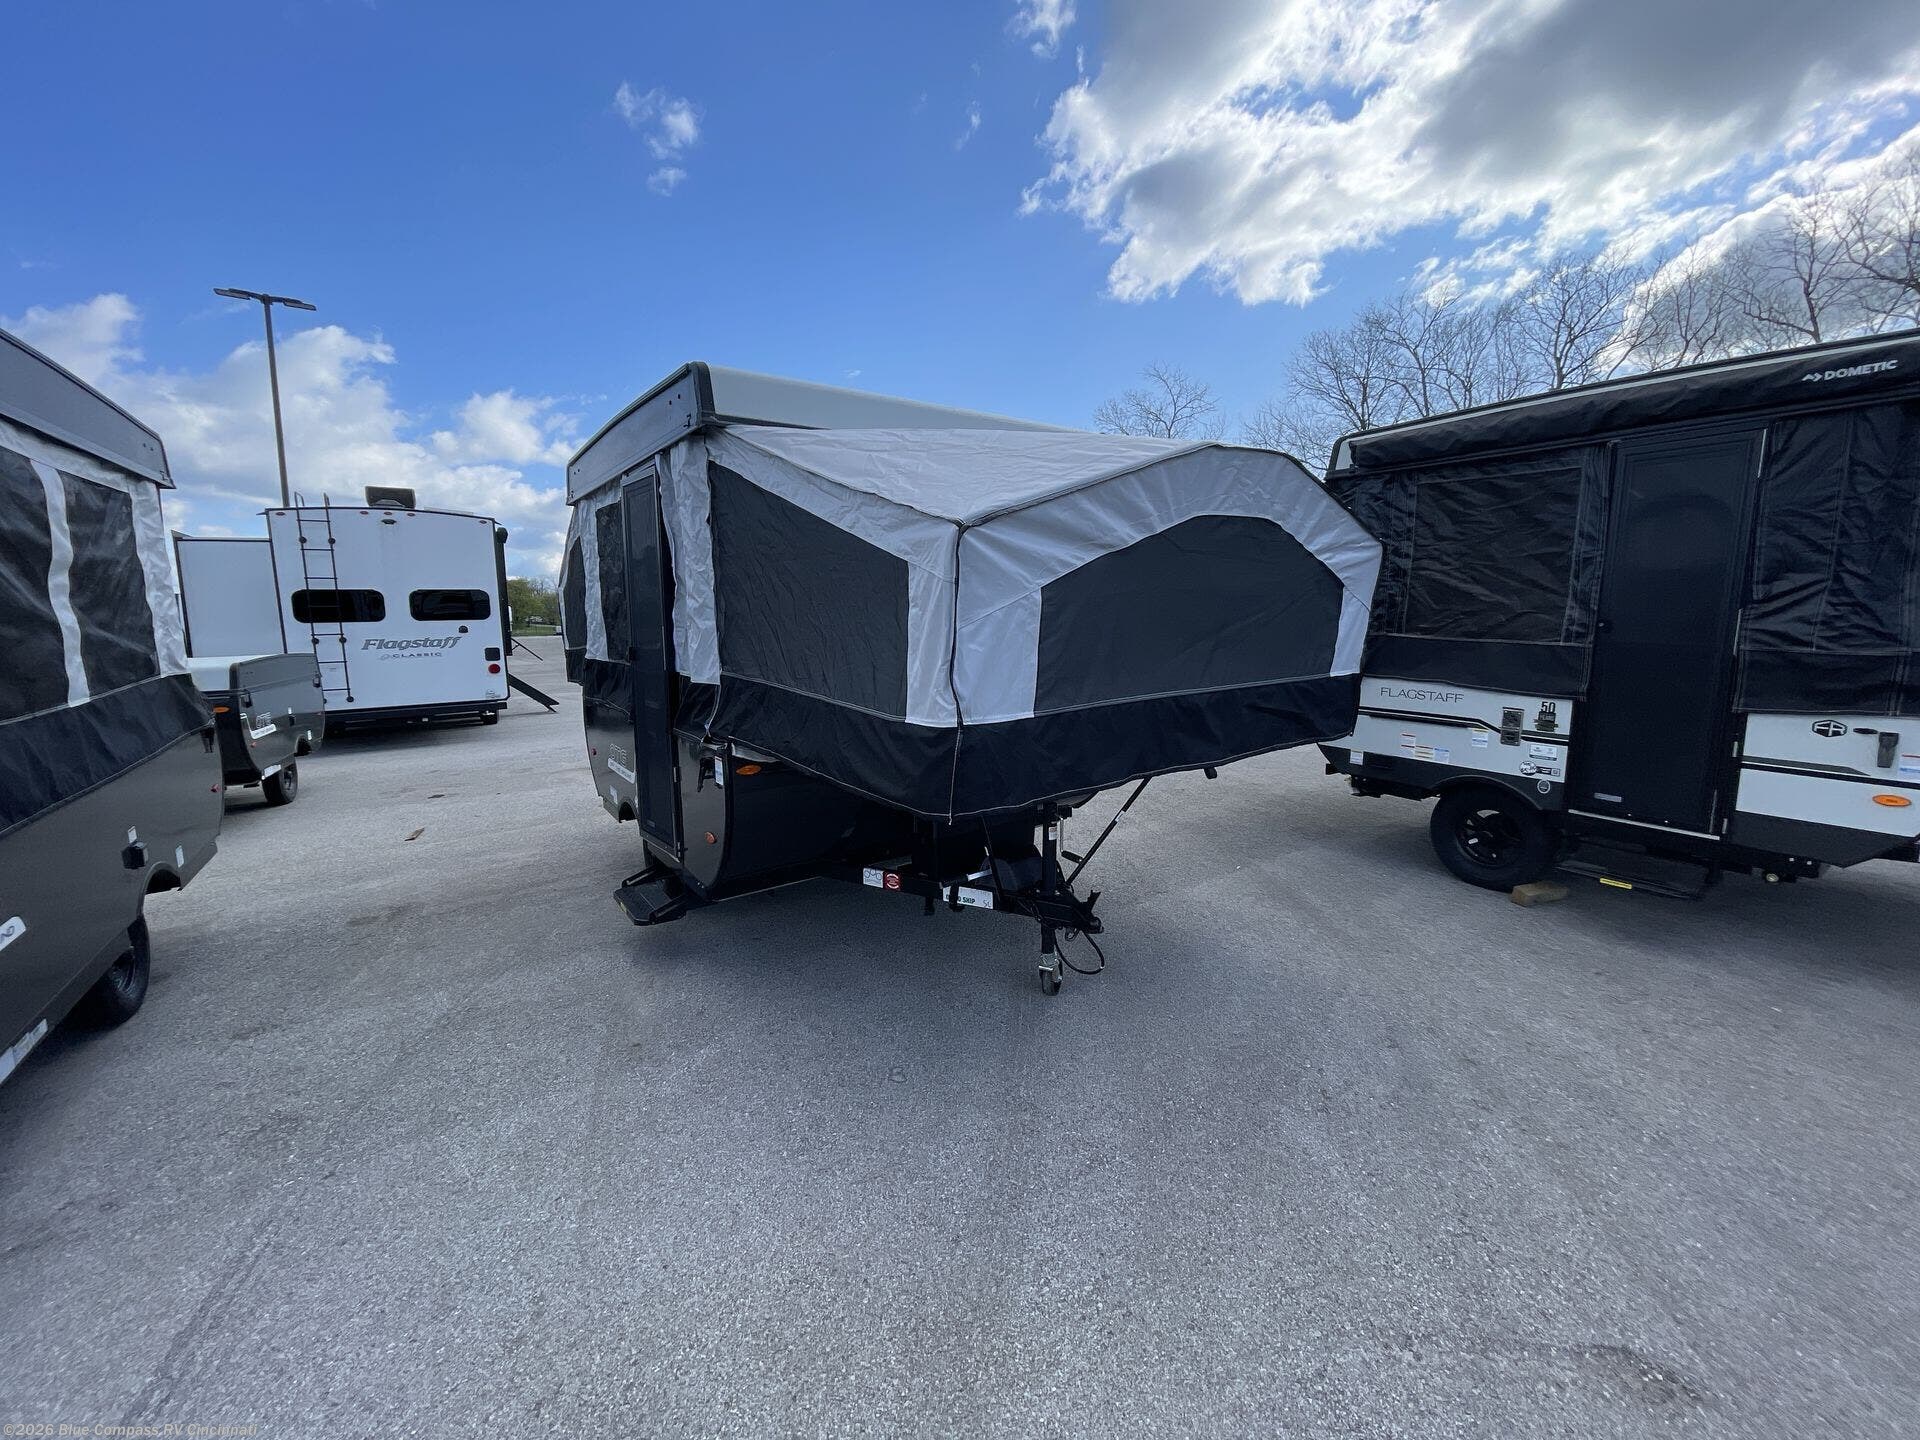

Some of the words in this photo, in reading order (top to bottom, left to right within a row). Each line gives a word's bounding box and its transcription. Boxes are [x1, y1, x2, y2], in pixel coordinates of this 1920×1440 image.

[1823, 359, 1898, 381] DOMETIC
[361, 636, 462, 651] Flagstaff
[1380, 687, 1465, 703] FLAGSTAFF
[1541, 701, 1556, 713] 50
